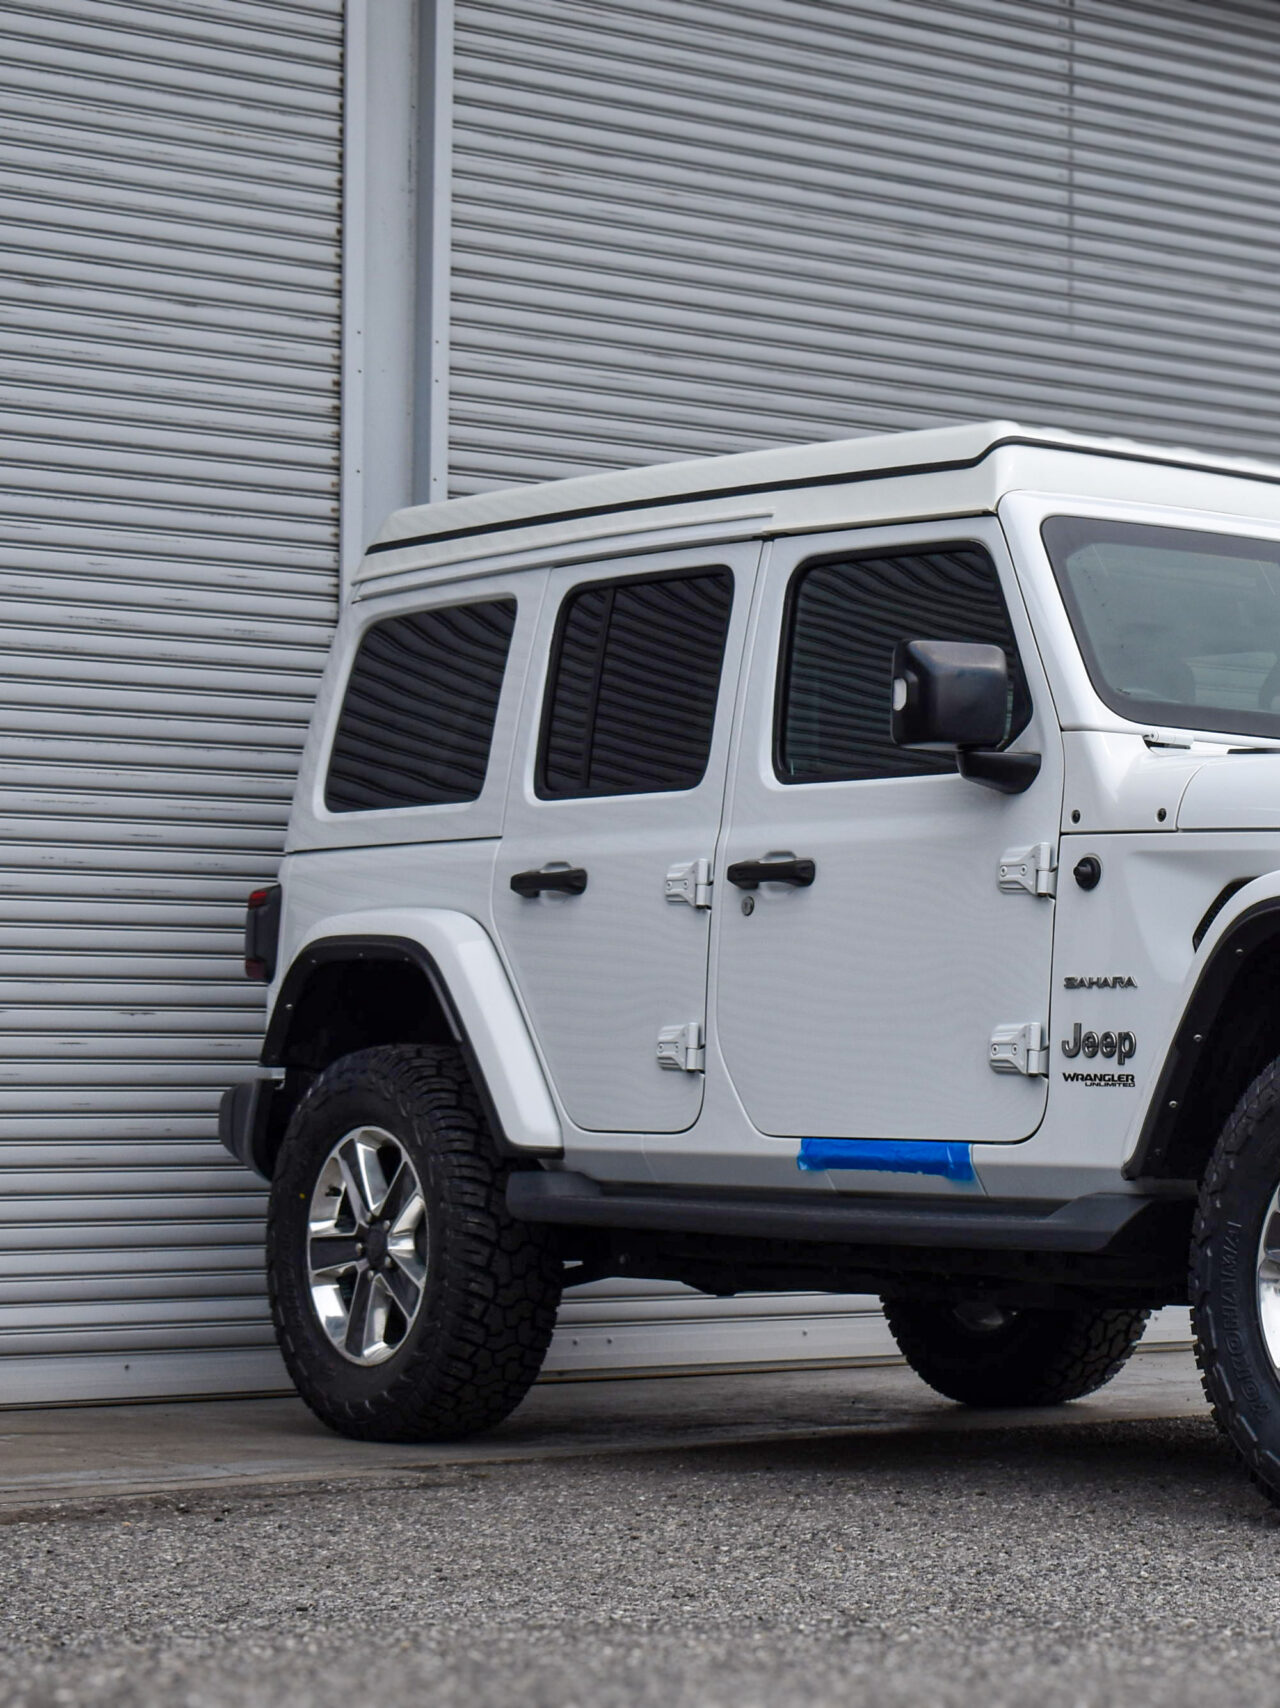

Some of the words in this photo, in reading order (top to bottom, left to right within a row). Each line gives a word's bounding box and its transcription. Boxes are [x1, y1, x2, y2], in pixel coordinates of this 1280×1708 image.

[1063, 976, 1138, 989] SAHARA
[1061, 1022, 1137, 1066] Jeep
[1062, 1072, 1135, 1083] WRANGLER
